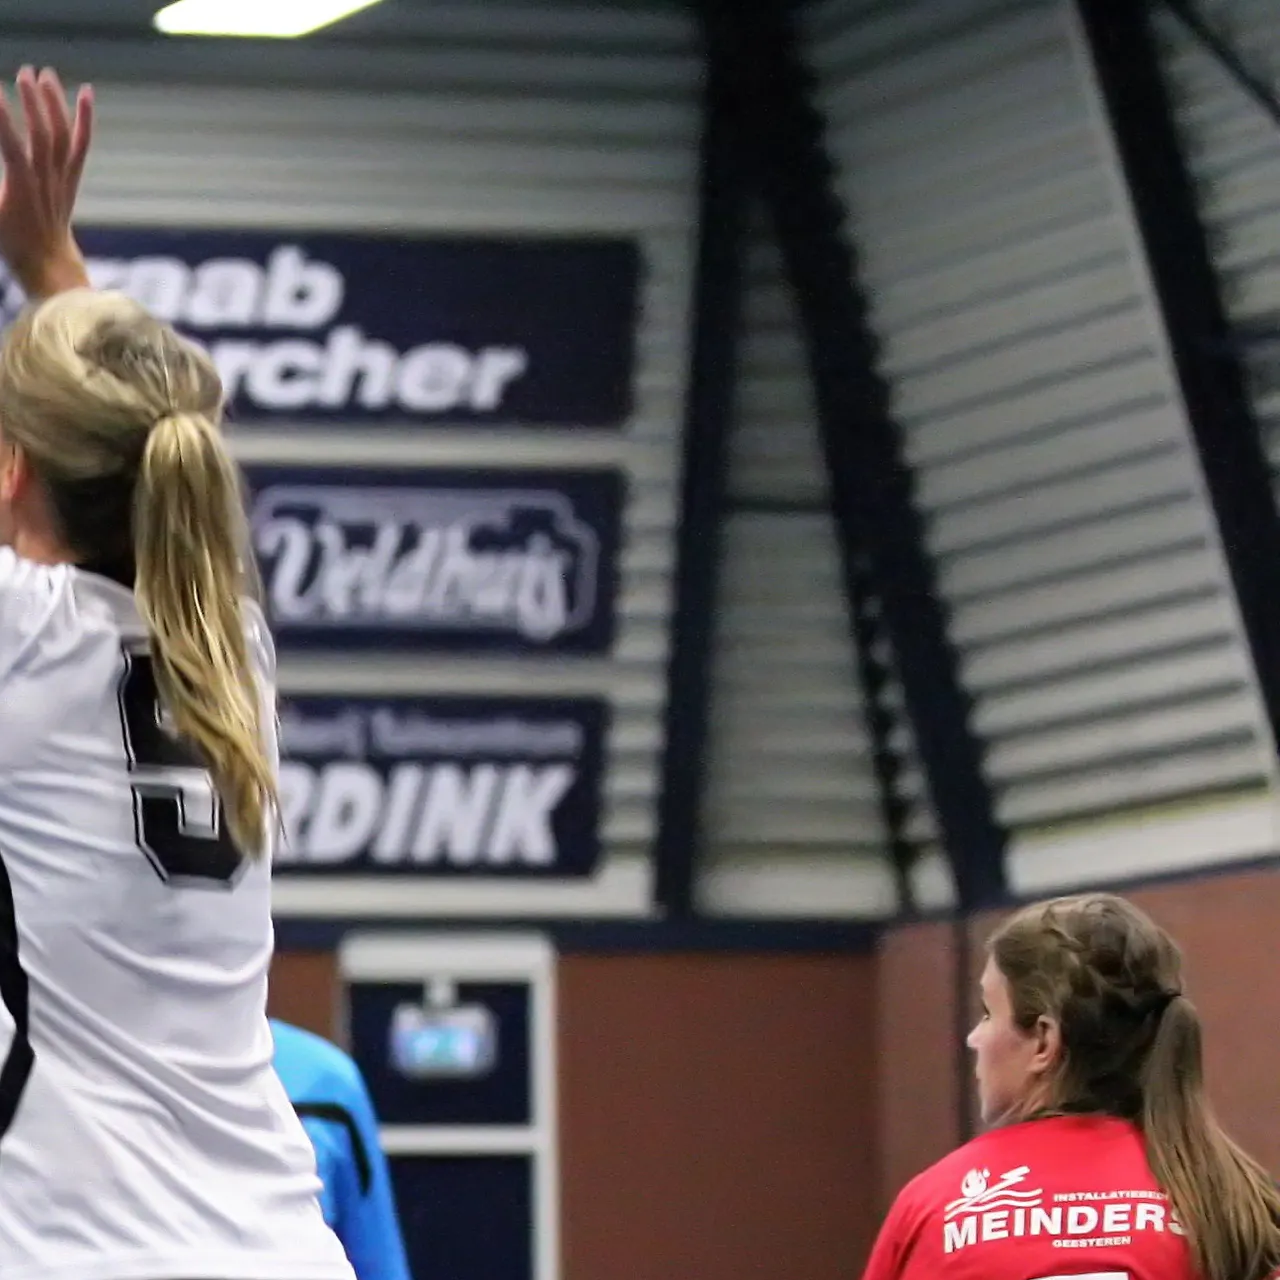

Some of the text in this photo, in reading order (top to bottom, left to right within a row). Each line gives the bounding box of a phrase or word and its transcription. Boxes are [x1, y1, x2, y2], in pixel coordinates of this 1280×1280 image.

[212, 324, 526, 411] rcher
[274, 762, 576, 866] RDINK
[1052, 1236, 1131, 1248] GEESTEREN
